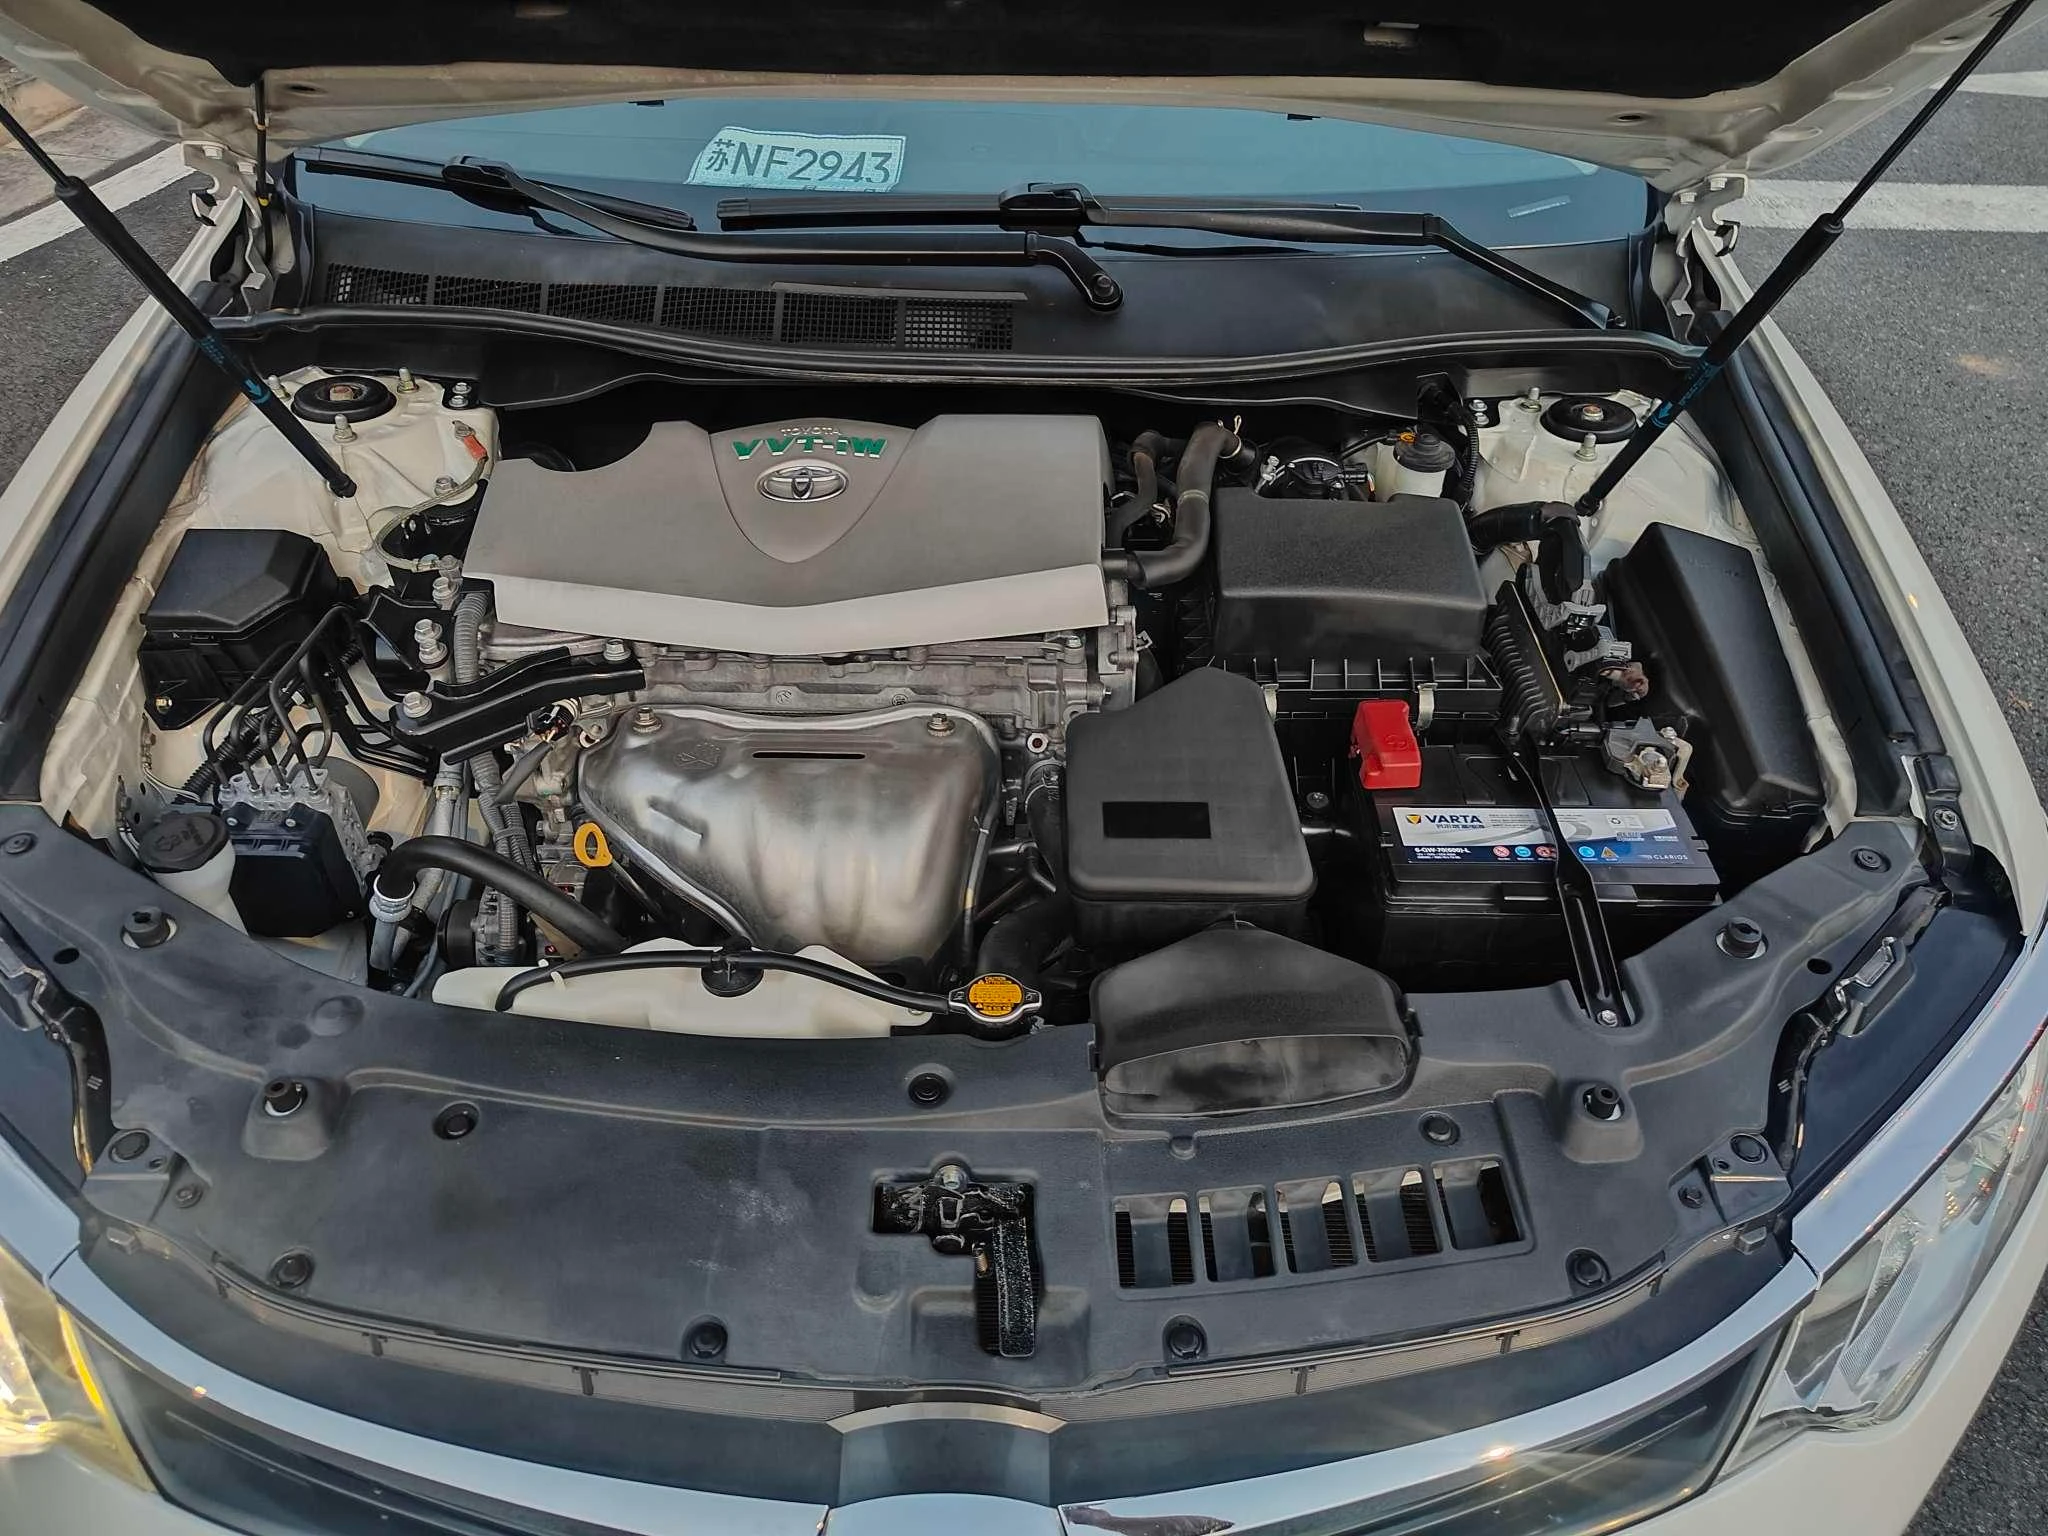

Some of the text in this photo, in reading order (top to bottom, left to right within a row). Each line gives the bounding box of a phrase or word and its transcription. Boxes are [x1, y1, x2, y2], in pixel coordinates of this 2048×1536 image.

[705, 138, 894, 184] 苏NF2943
[780, 426, 842, 437] TOYOTA
[1424, 814, 1483, 824] VARTA
